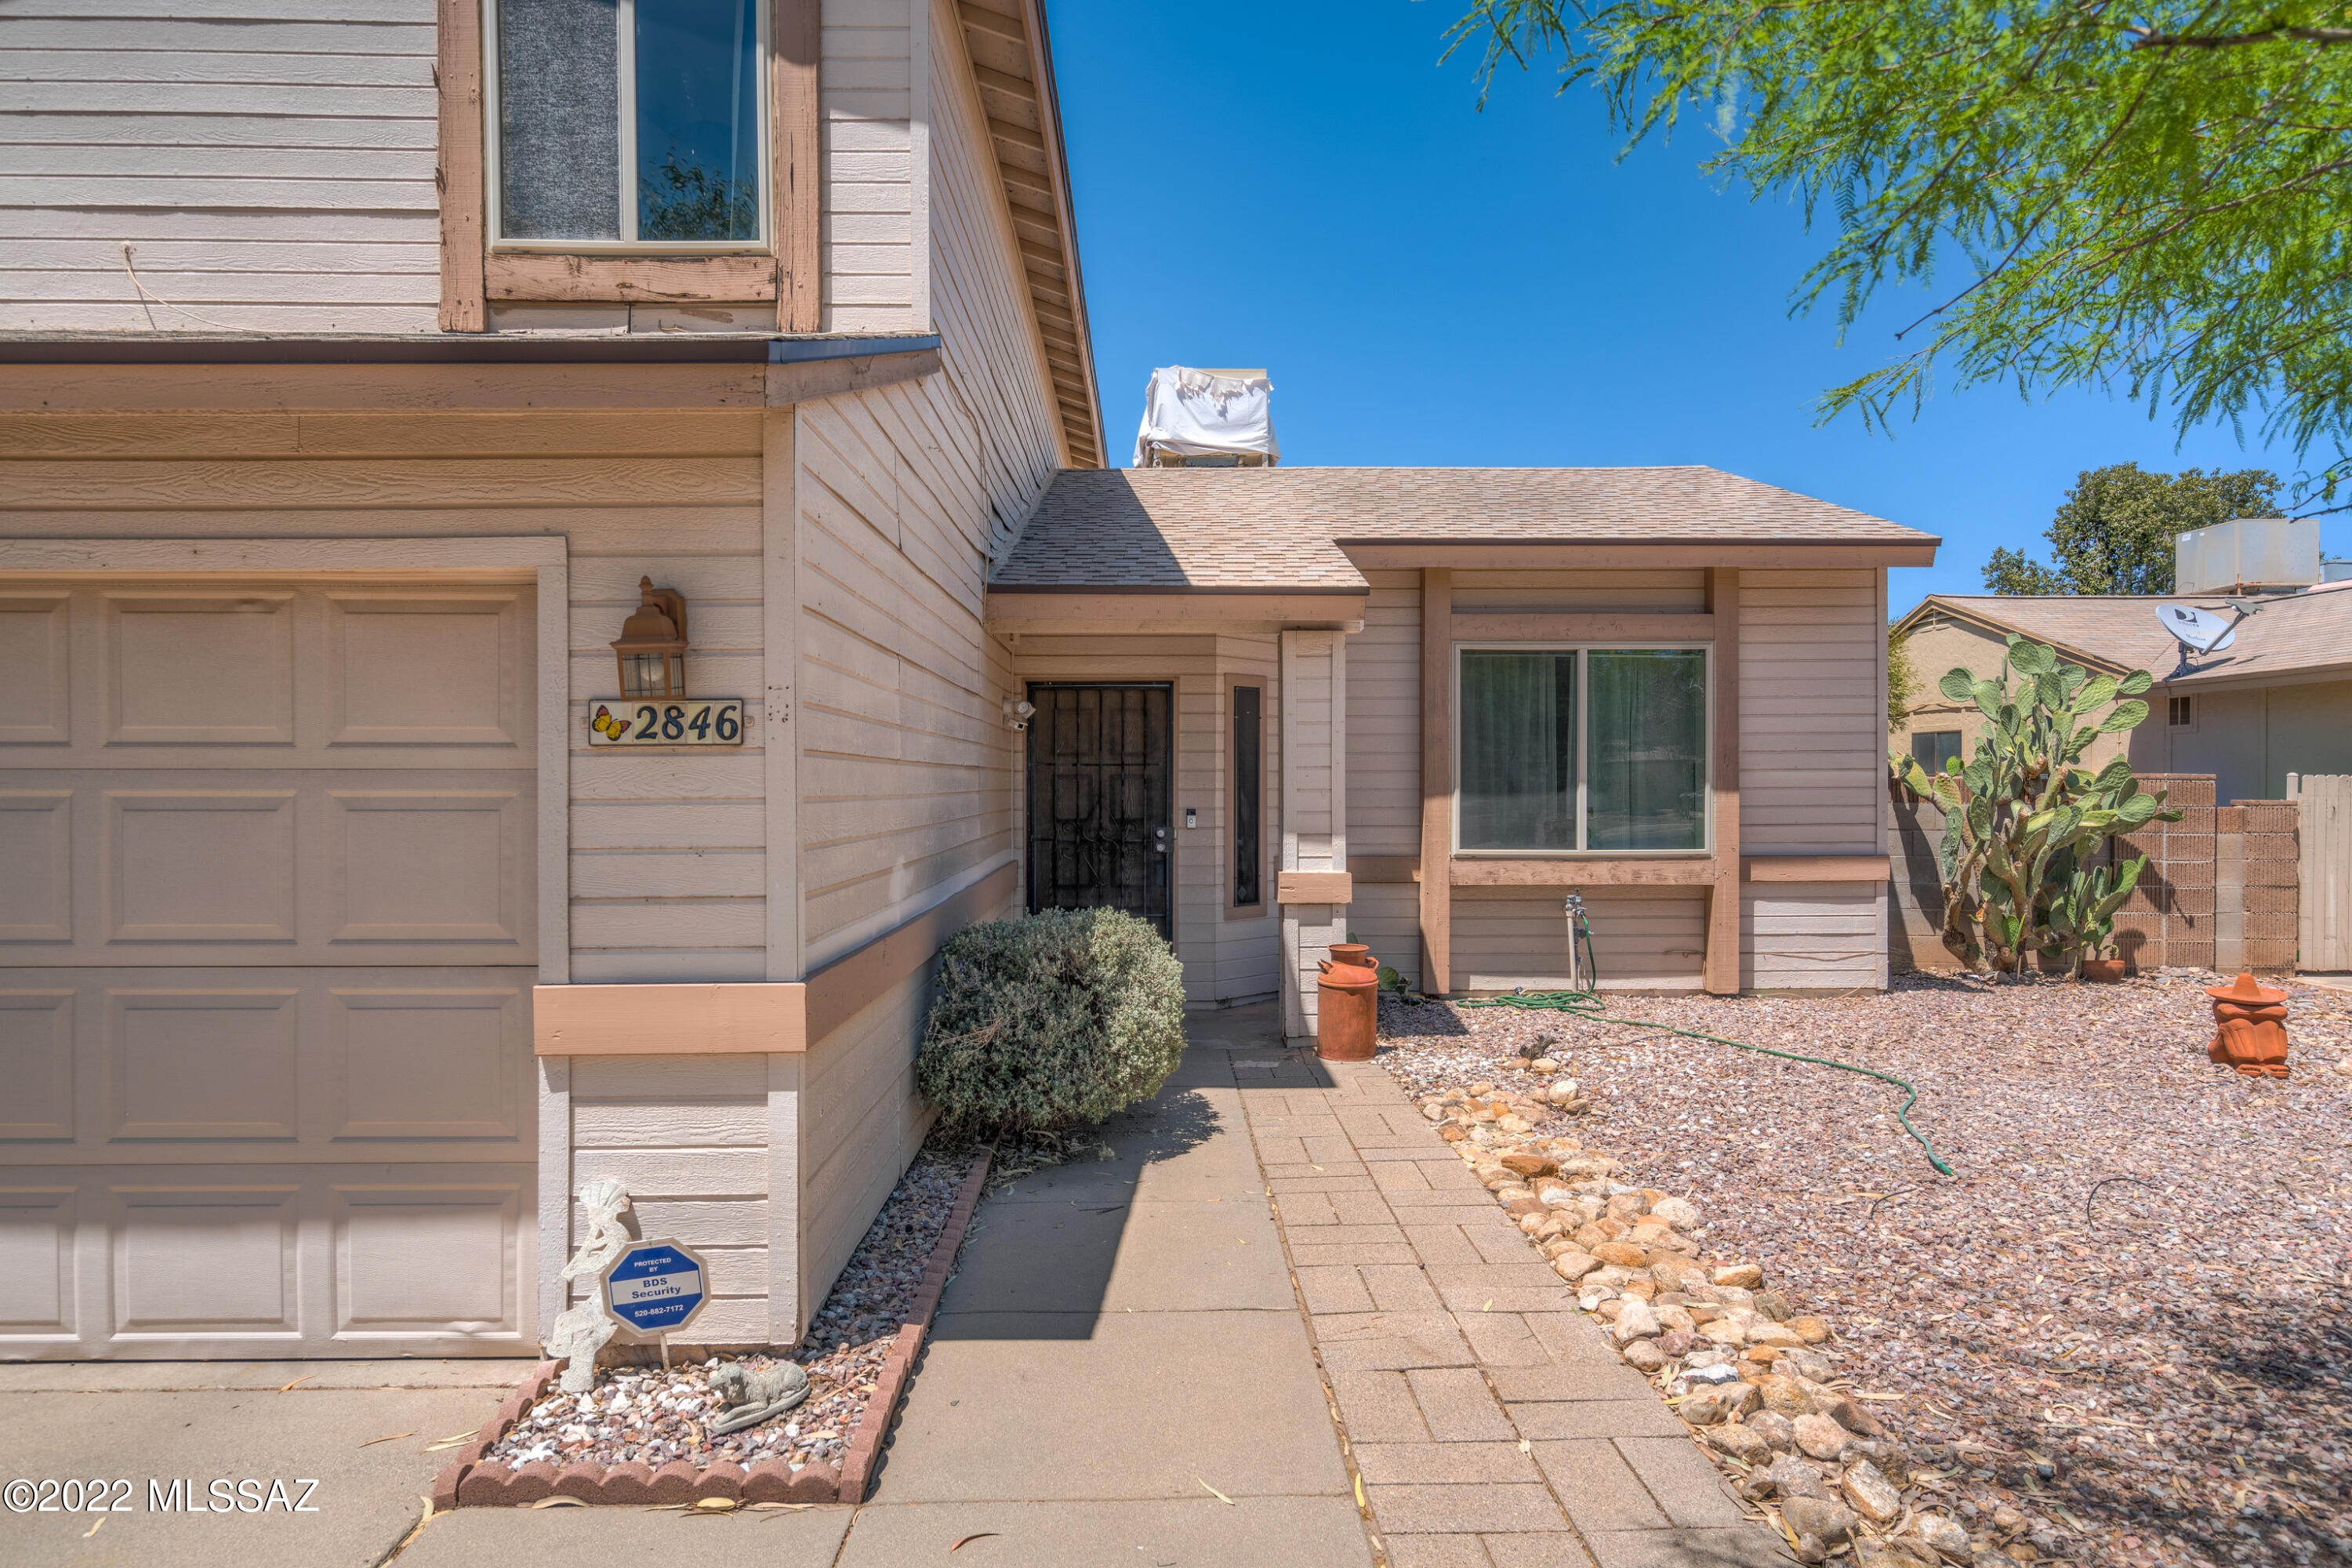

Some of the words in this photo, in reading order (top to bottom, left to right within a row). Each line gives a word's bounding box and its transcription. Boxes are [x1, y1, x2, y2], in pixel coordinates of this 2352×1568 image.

[635, 706, 739, 740] 2846
[634, 1258, 671, 1267] PROTECTED
[643, 1278, 667, 1287] BDS
[632, 1286, 681, 1299] Security
[634, 1305, 684, 1317] 520-882-7172
